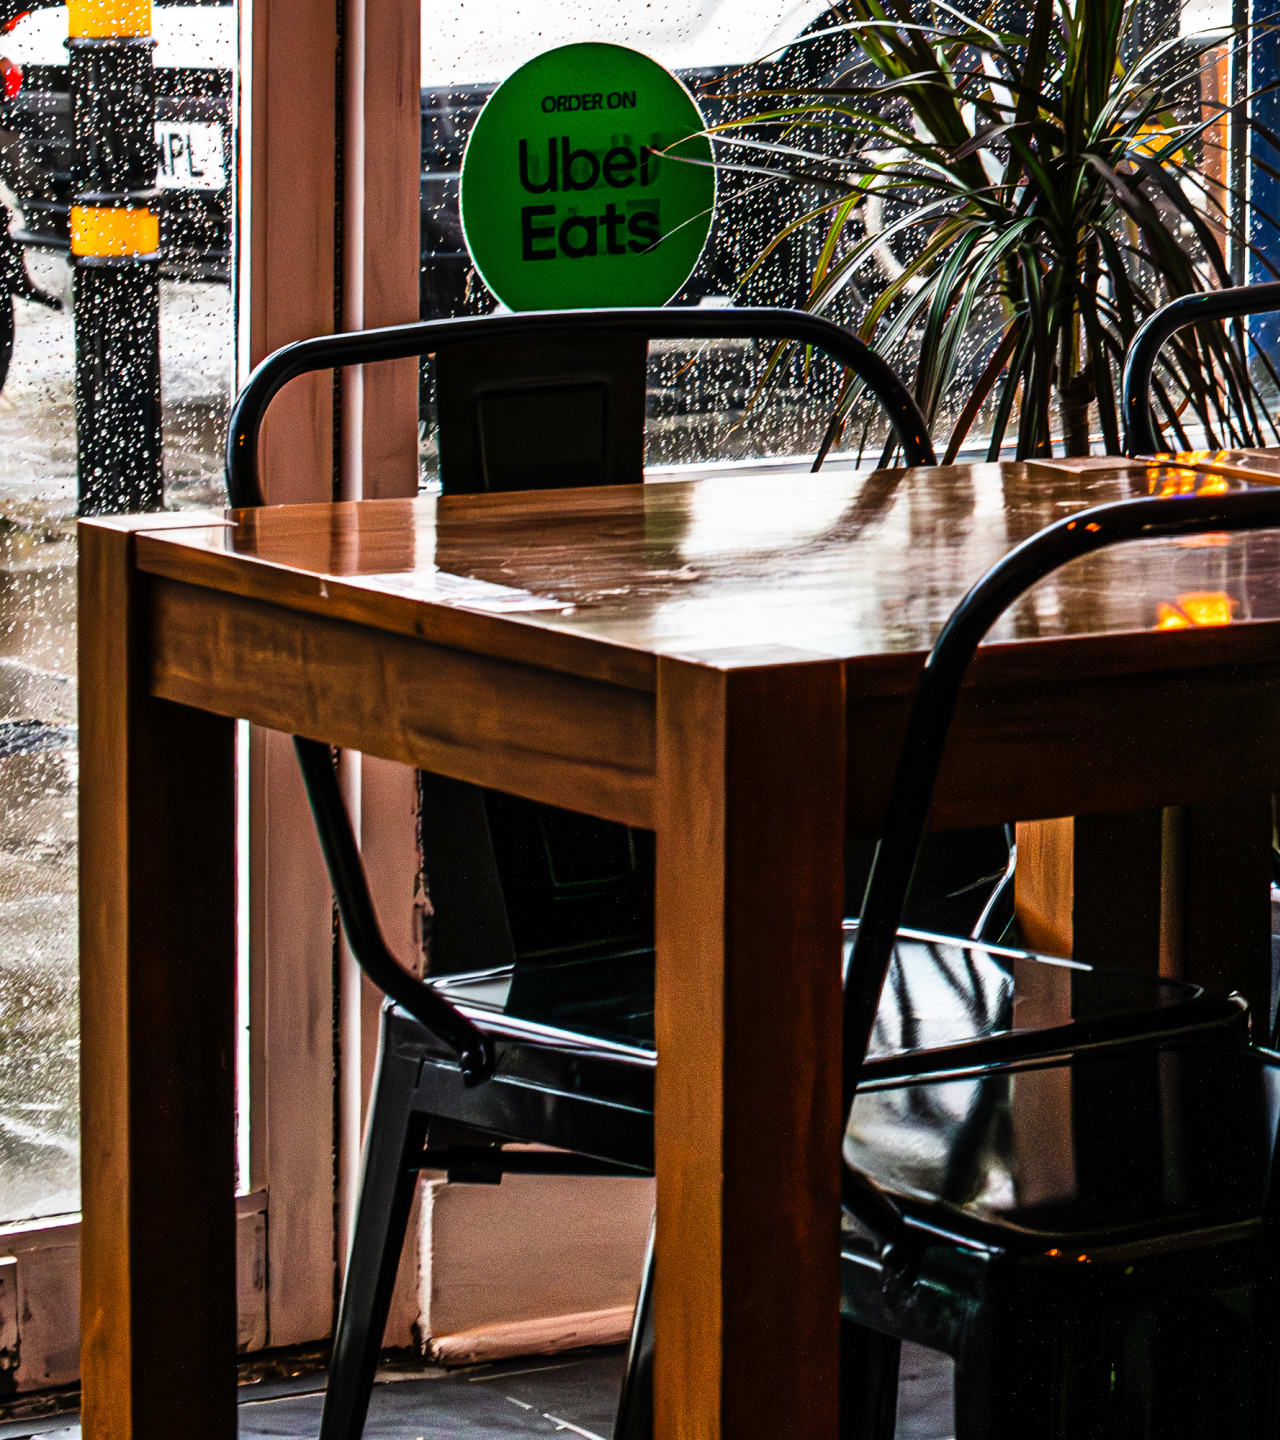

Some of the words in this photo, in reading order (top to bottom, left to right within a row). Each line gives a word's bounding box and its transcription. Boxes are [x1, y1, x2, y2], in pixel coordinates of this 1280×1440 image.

[541, 93, 603, 114] ORDER
[606, 91, 637, 110] ON
[518, 134, 661, 194] Uber
[520, 203, 661, 261] Eats
